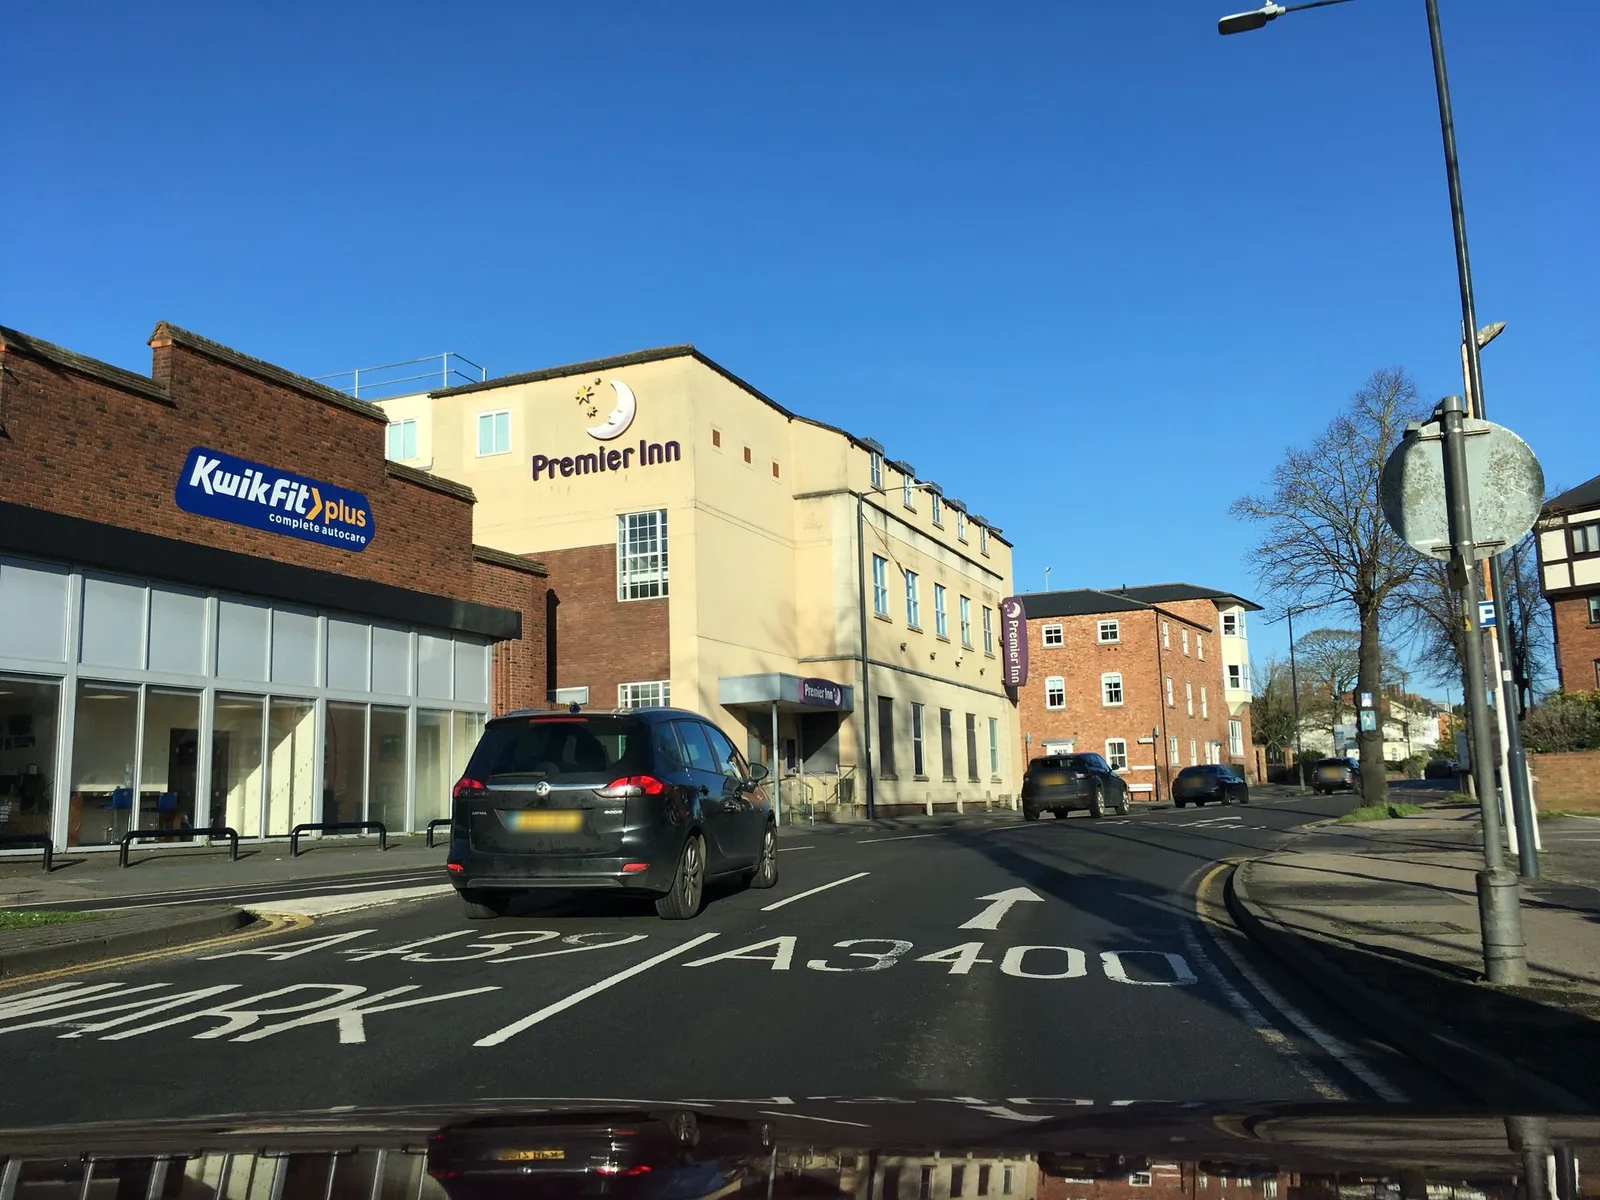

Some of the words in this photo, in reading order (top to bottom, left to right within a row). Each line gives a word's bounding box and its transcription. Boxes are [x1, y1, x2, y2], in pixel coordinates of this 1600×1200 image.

[532, 446, 635, 481] Premier
[640, 440, 681, 466] Inn
[325, 499, 366, 527] plus
[269, 513, 319, 534] complete
[322, 526, 366, 544] autocare
[1479, 604, 1495, 625] P
[1008, 620, 1021, 663] Premier
[1010, 665, 1021, 683] Inn
[804, 683, 824, 698] Premier
[825, 687, 833, 700] Inn
[682, 935, 1198, 986] A3400
